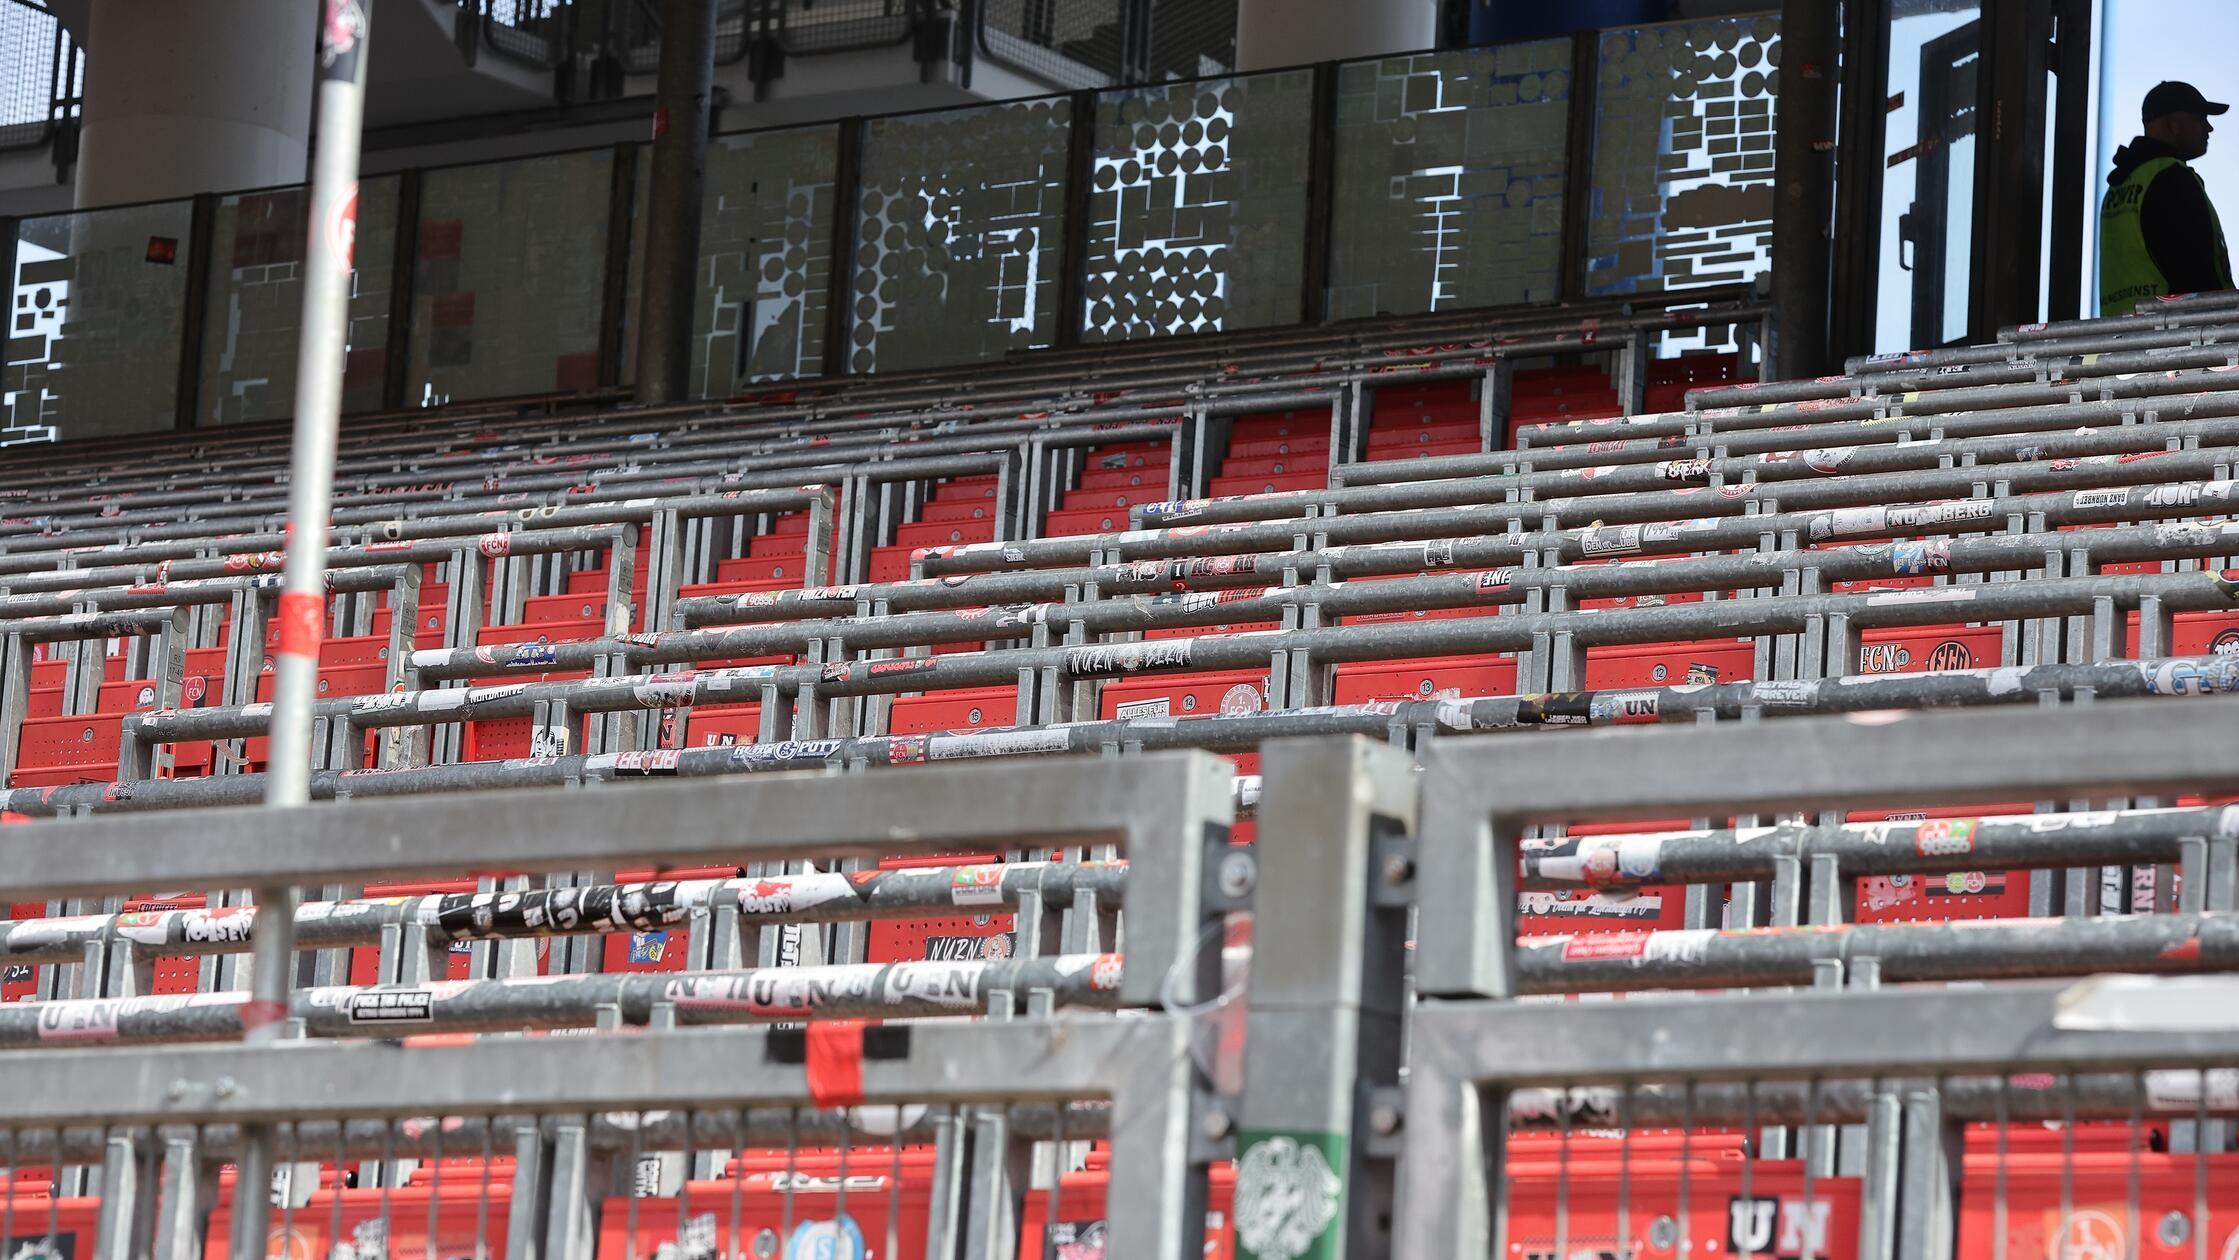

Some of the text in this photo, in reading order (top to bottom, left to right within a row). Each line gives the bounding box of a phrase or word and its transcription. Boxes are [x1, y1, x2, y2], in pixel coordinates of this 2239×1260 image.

[1860, 643, 1896, 673] FCN
[1654, 667, 1666, 679] 12
[187, 686, 202, 698] FCN
[1421, 681, 1432, 693] 13
[1184, 697, 1195, 709] 14
[1624, 699, 1656, 717] UN
[970, 710, 981, 722] 15
[1121, 705, 1148, 718] ALLES
[1149, 703, 1167, 715] FÜR
